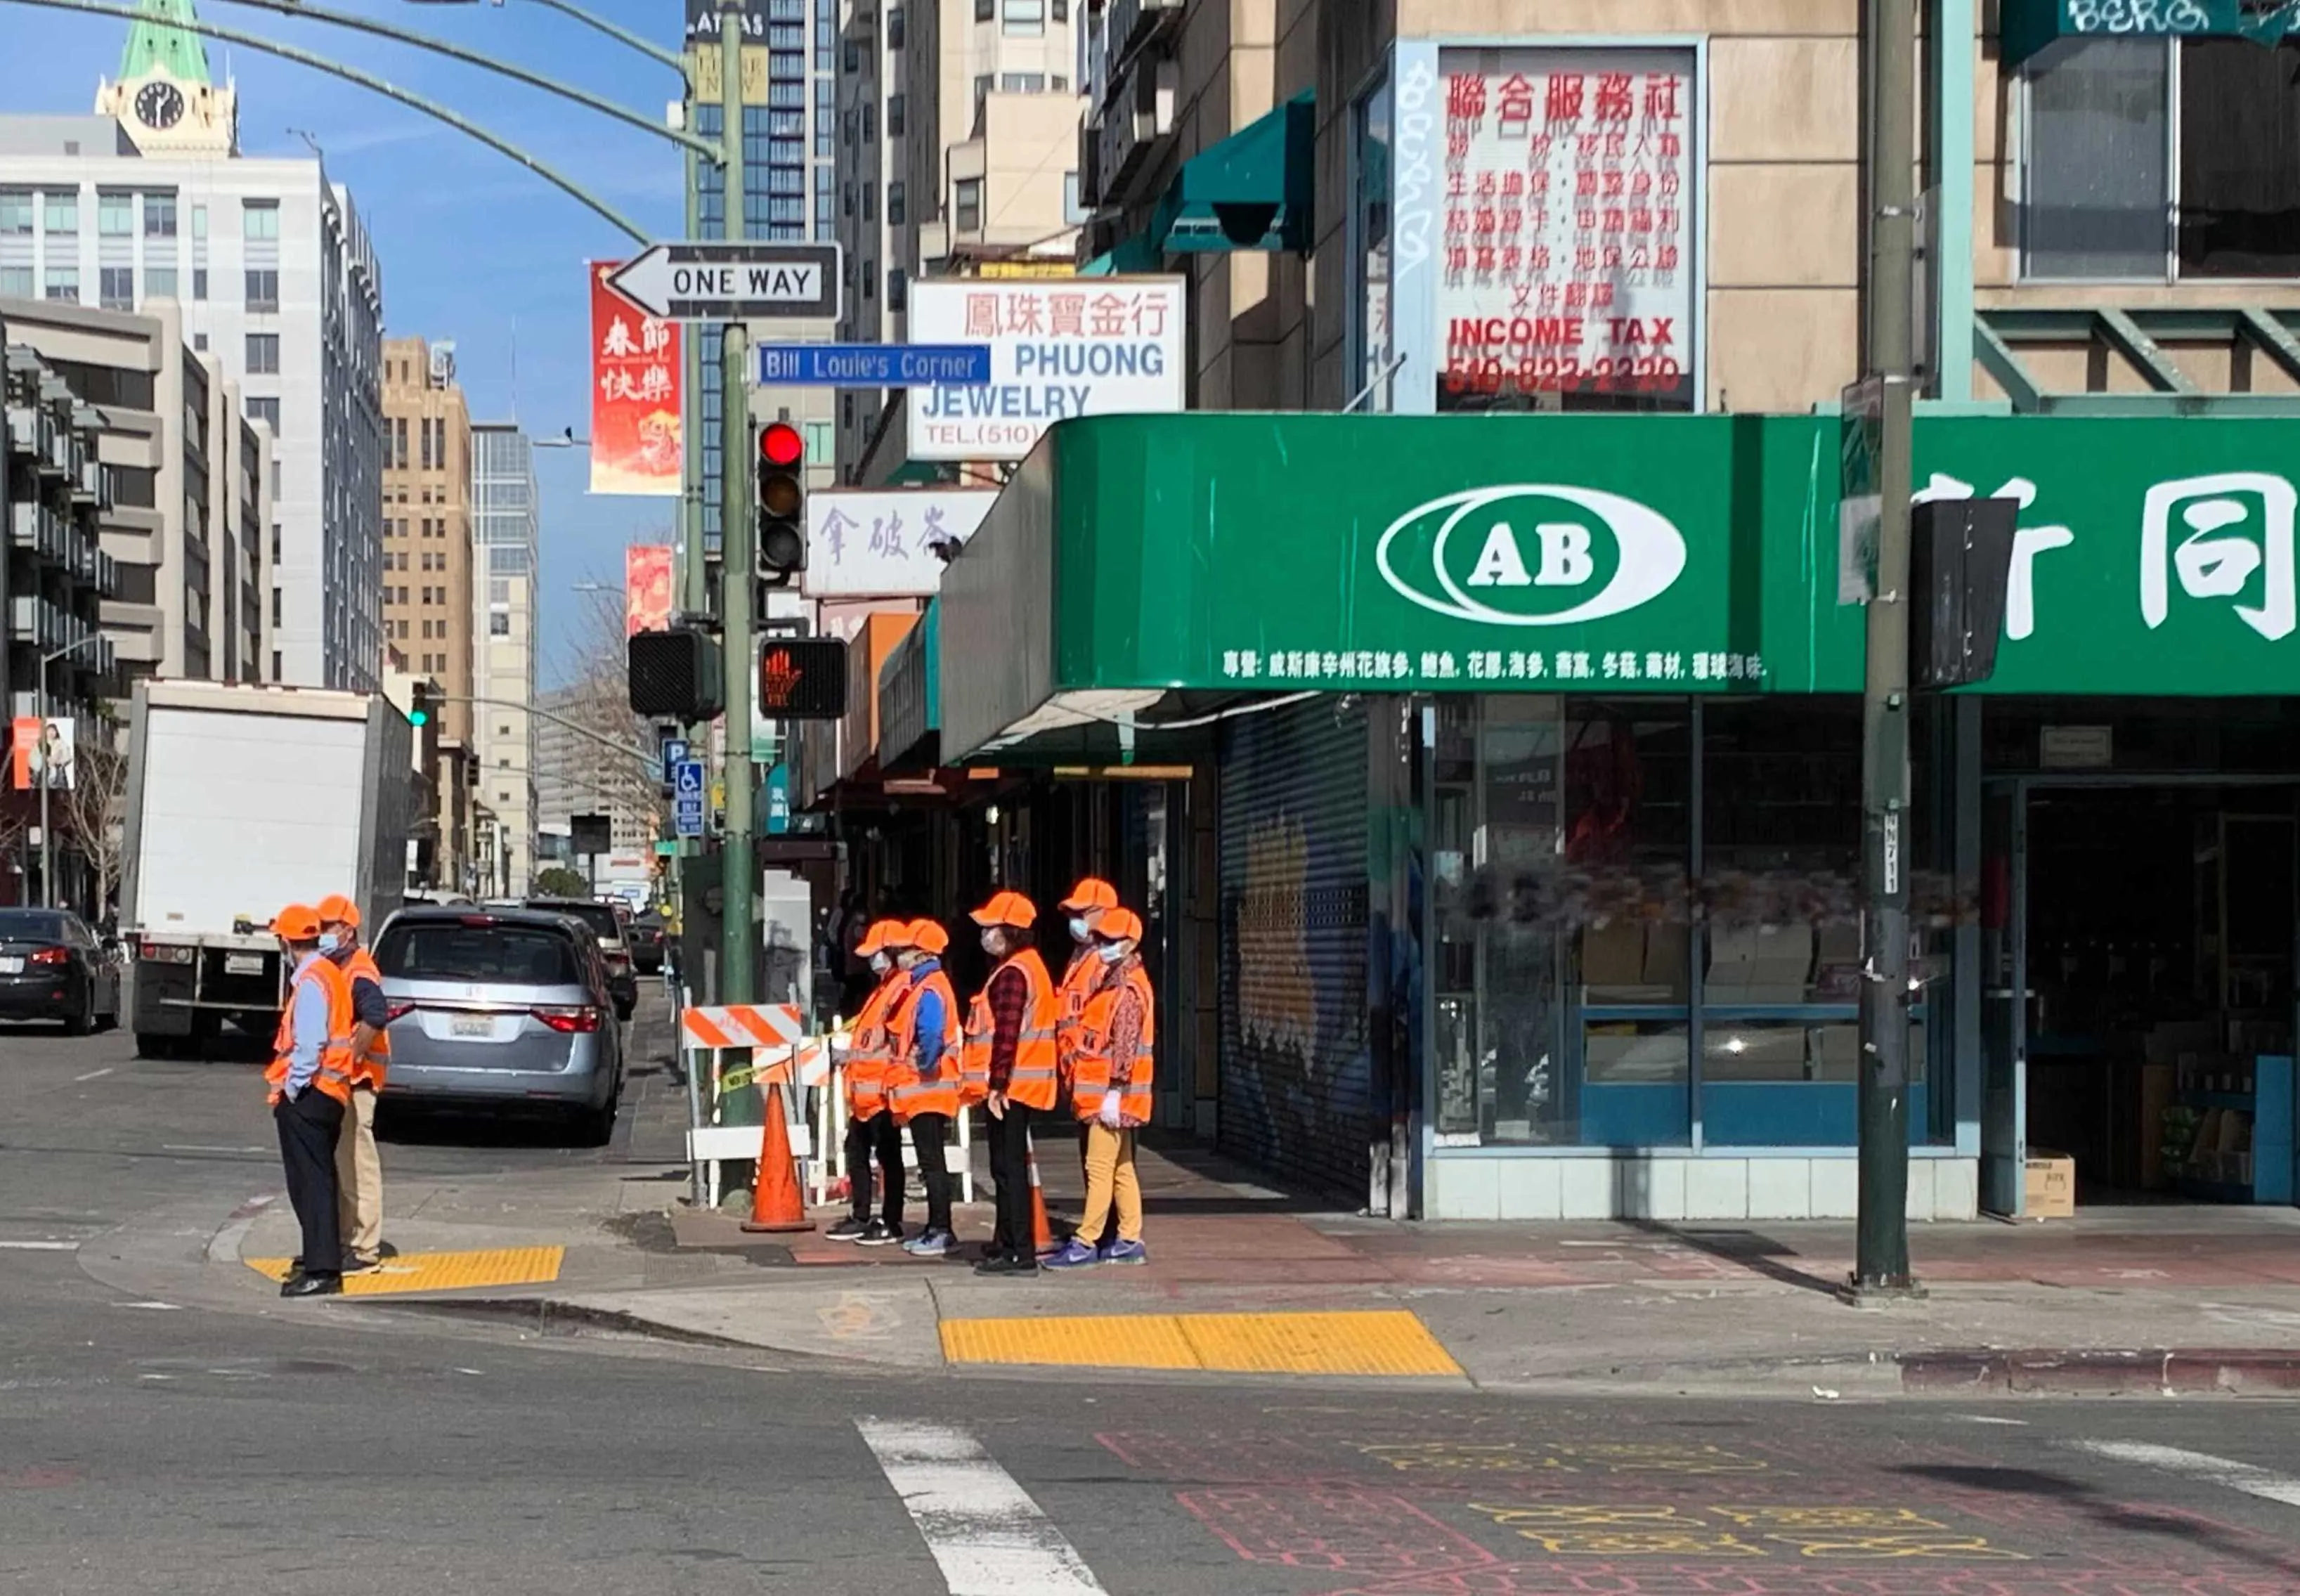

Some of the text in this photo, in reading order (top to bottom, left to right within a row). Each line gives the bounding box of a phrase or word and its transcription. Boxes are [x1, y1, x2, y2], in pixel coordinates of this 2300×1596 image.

[1446, 73, 1682, 120] 聯合服務社
[674, 268, 811, 294] ONE WAY
[965, 292, 1168, 337] 鳳珠寶金行
[1450, 318, 1674, 345] INCOME TAX
[767, 351, 976, 378] Bill Louie's Corner
[1015, 343, 1164, 376] PHUONG
[923, 384, 1091, 418] JEWELRY
[1467, 521, 1594, 586] AB
